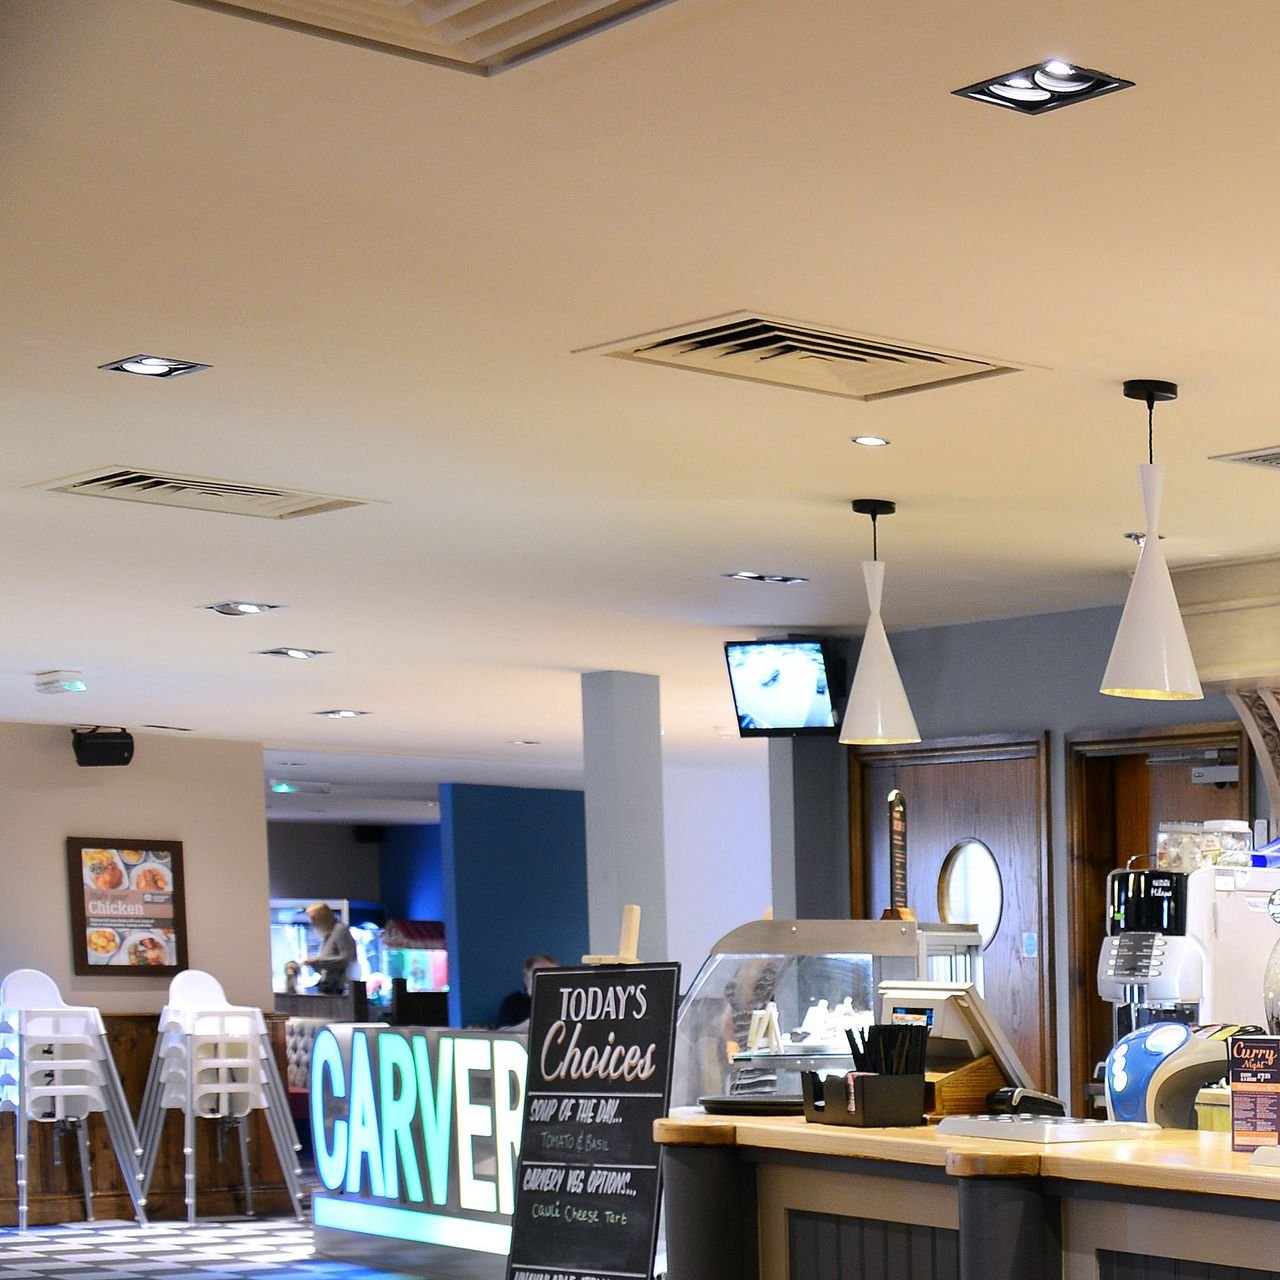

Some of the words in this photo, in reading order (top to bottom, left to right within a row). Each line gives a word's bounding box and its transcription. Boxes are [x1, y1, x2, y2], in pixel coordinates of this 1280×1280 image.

[88, 901, 144, 915] Chicken
[560, 984, 648, 1021] TODAY'S
[540, 1020, 657, 1082] Choices
[1233, 1041, 1278, 1065] Curry
[1241, 1059, 1267, 1071] Night
[310, 1029, 528, 1216] CARVER
[529, 1098, 558, 1122] SOUP
[558, 1099, 574, 1122] OF
[576, 1099, 596, 1123] THE
[541, 1131, 574, 1149] TOMATO
[585, 1133, 609, 1151] BASIL
[522, 1168, 565, 1192] CARVERY
[566, 1169, 584, 1194] VEG
[564, 1206, 600, 1223] Cheese
